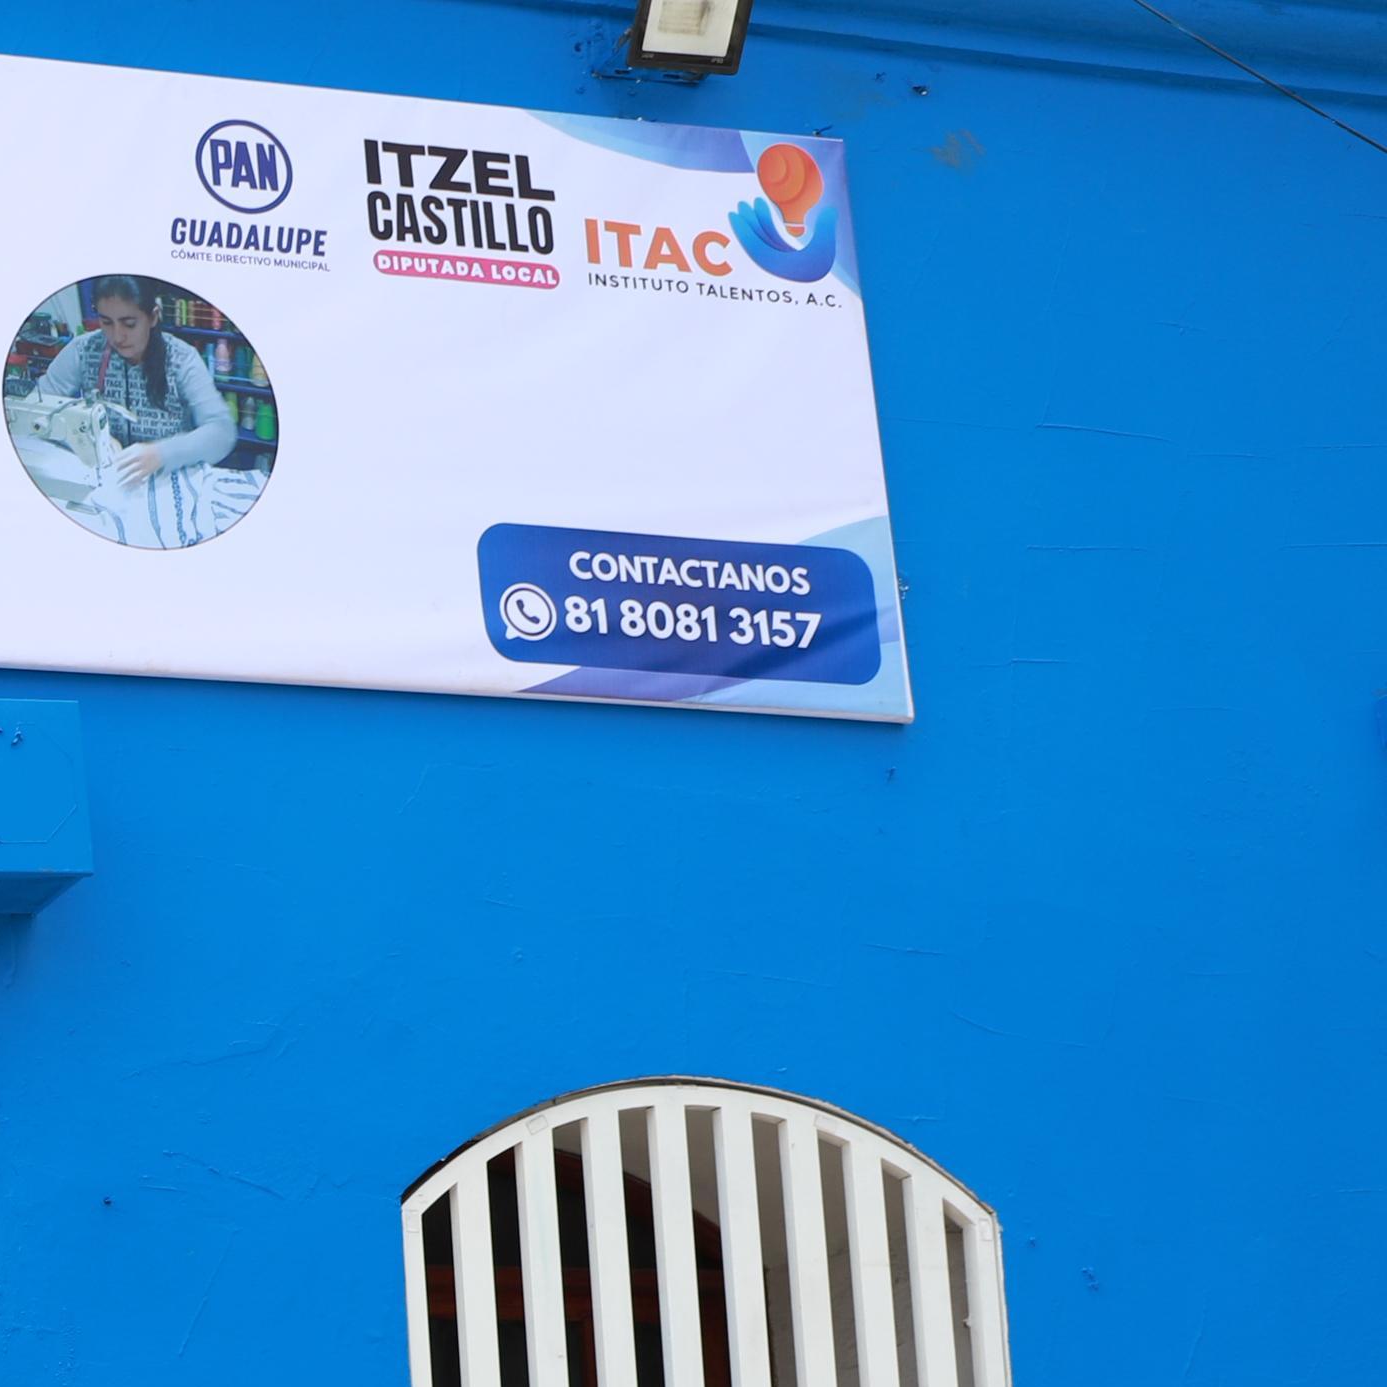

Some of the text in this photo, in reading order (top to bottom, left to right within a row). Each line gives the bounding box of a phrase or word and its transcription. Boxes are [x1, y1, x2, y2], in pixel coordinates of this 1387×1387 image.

[208, 138, 281, 193] PAN
[364, 139, 555, 201] ITZEL
[171, 218, 327, 256] GUADALUPE
[367, 191, 554, 255] CASTILLO
[215, 253, 271, 266] DIRECTIVO
[274, 258, 330, 272] MUNICIPAL
[377, 256, 558, 285] DIPUTADA LOCAL
[585, 219, 734, 277] ITAC
[589, 273, 841, 307] INSTITUTO TALENTOS, A.C.
[570, 551, 810, 595] CONTACTANOS
[565, 596, 821, 649] 81 8081 3157
